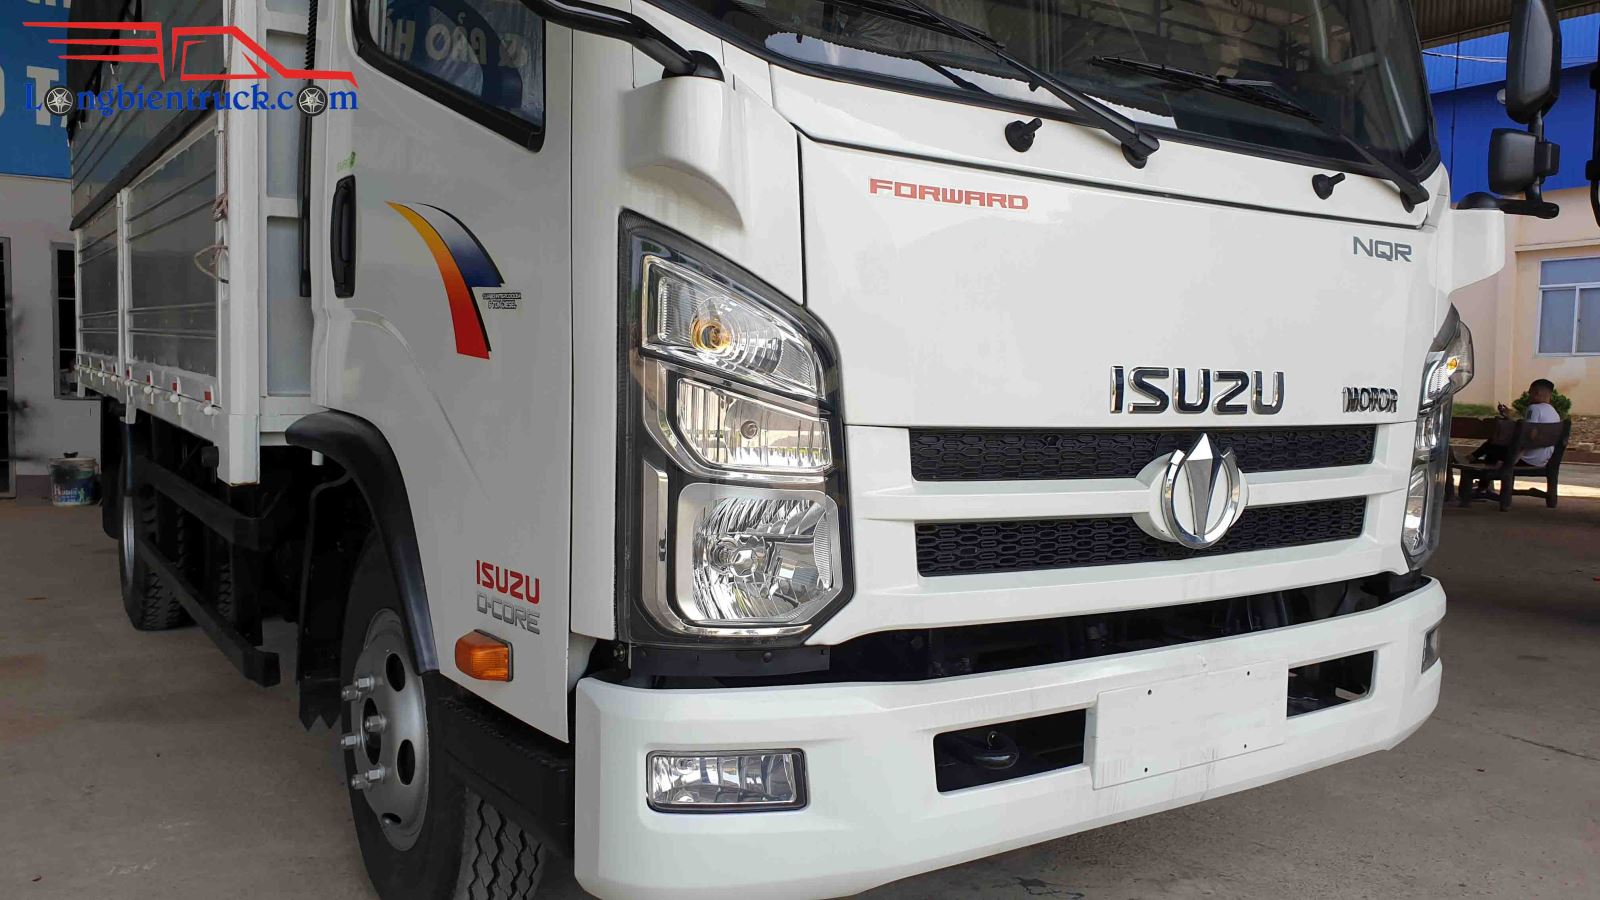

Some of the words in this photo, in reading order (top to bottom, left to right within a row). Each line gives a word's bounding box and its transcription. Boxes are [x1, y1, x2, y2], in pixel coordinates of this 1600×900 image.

[869, 178, 1029, 210] FORWARD
[1353, 236, 1413, 263] NQR
[1109, 365, 1285, 415] ISUZU
[476, 559, 540, 605] ISUZU
